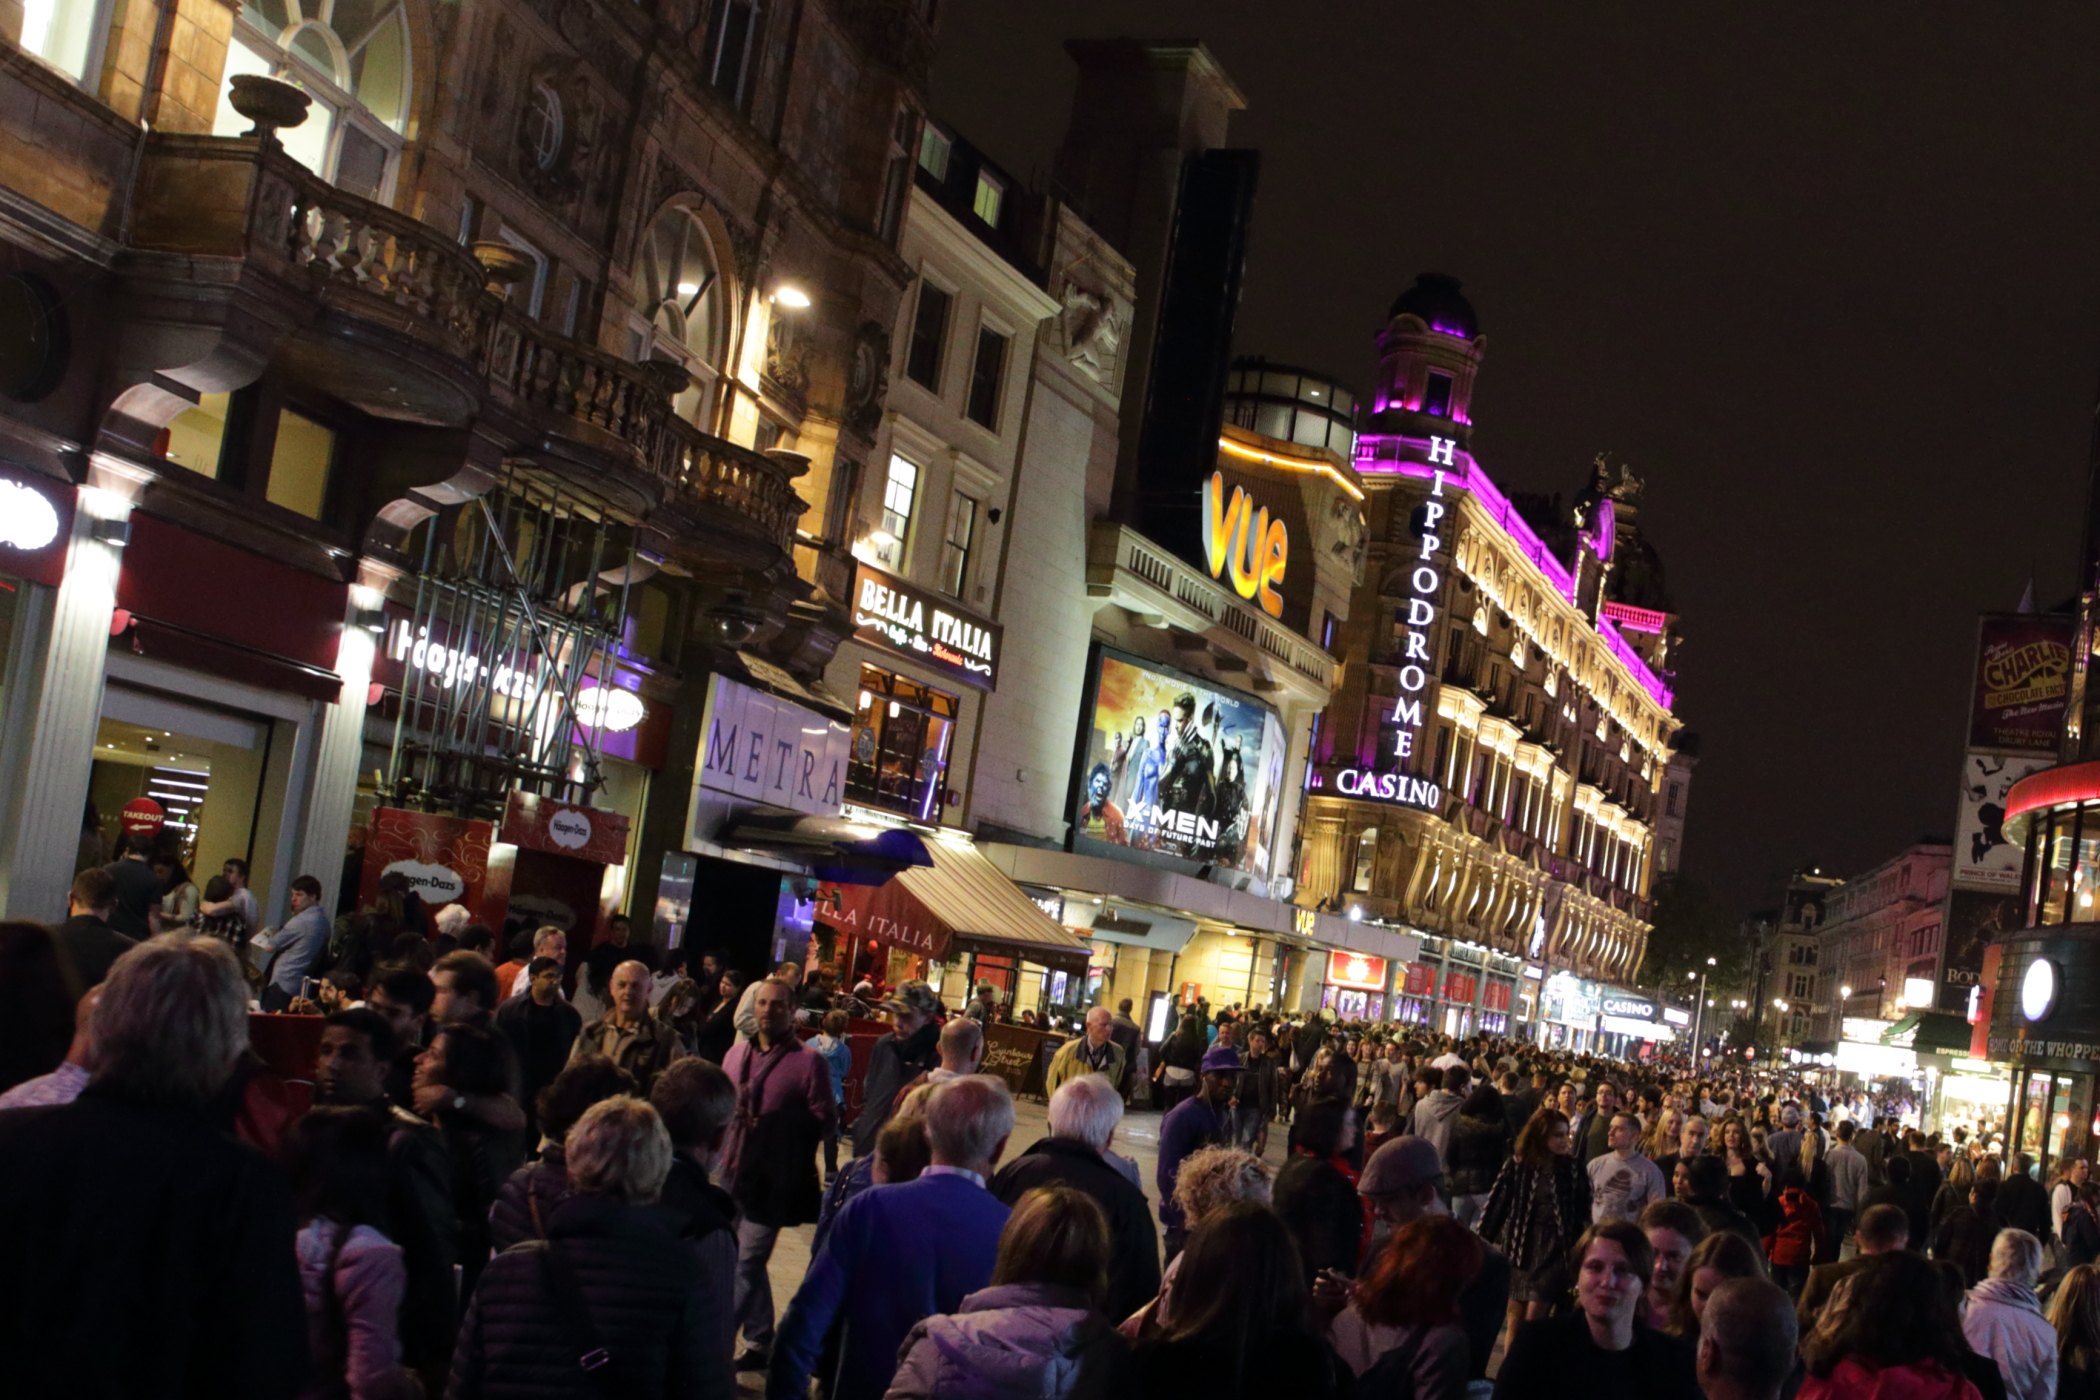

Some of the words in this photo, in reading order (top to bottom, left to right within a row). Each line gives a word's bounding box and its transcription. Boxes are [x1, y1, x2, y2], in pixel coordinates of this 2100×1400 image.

[1391, 435, 1457, 758] HIPPODROME
[859, 578, 923, 633] BELLA
[931, 609, 992, 661] ITALIA
[1986, 643, 2068, 687] CHARLIE
[1164, 678, 1188, 692] MOVIE
[1189, 686, 1198, 695] IN
[1200, 690, 1213, 700] THE
[1213, 693, 1240, 708] WORLD
[1997, 687, 2043, 705] CHOCOLATE
[2002, 708, 2018, 720] The
[1993, 727, 2030, 737] THEATRE
[2031, 729, 2057, 739] ROYAL
[1998, 735, 2026, 745] DRURY
[2029, 738, 2051, 748] LANE
[705, 718, 839, 807] METRA
[1336, 768, 1440, 810] CASINO
[122, 810, 164, 822] TAKEOUT
[1125, 798, 1219, 840] X-MEN
[1123, 821, 1145, 832] DAYS
[1148, 825, 1159, 835] OF
[1161, 829, 1193, 844] FUTURE
[1196, 837, 1216, 849] PAST
[1959, 868, 1985, 877] PRINCE
[867, 915, 933, 951] ITALIA
[1603, 999, 1654, 1017] CASINO
[2010, 1038, 2023, 1053] OF
[2023, 1039, 2045, 1056] THE
[2046, 1041, 2100, 1061] WHOPPE
